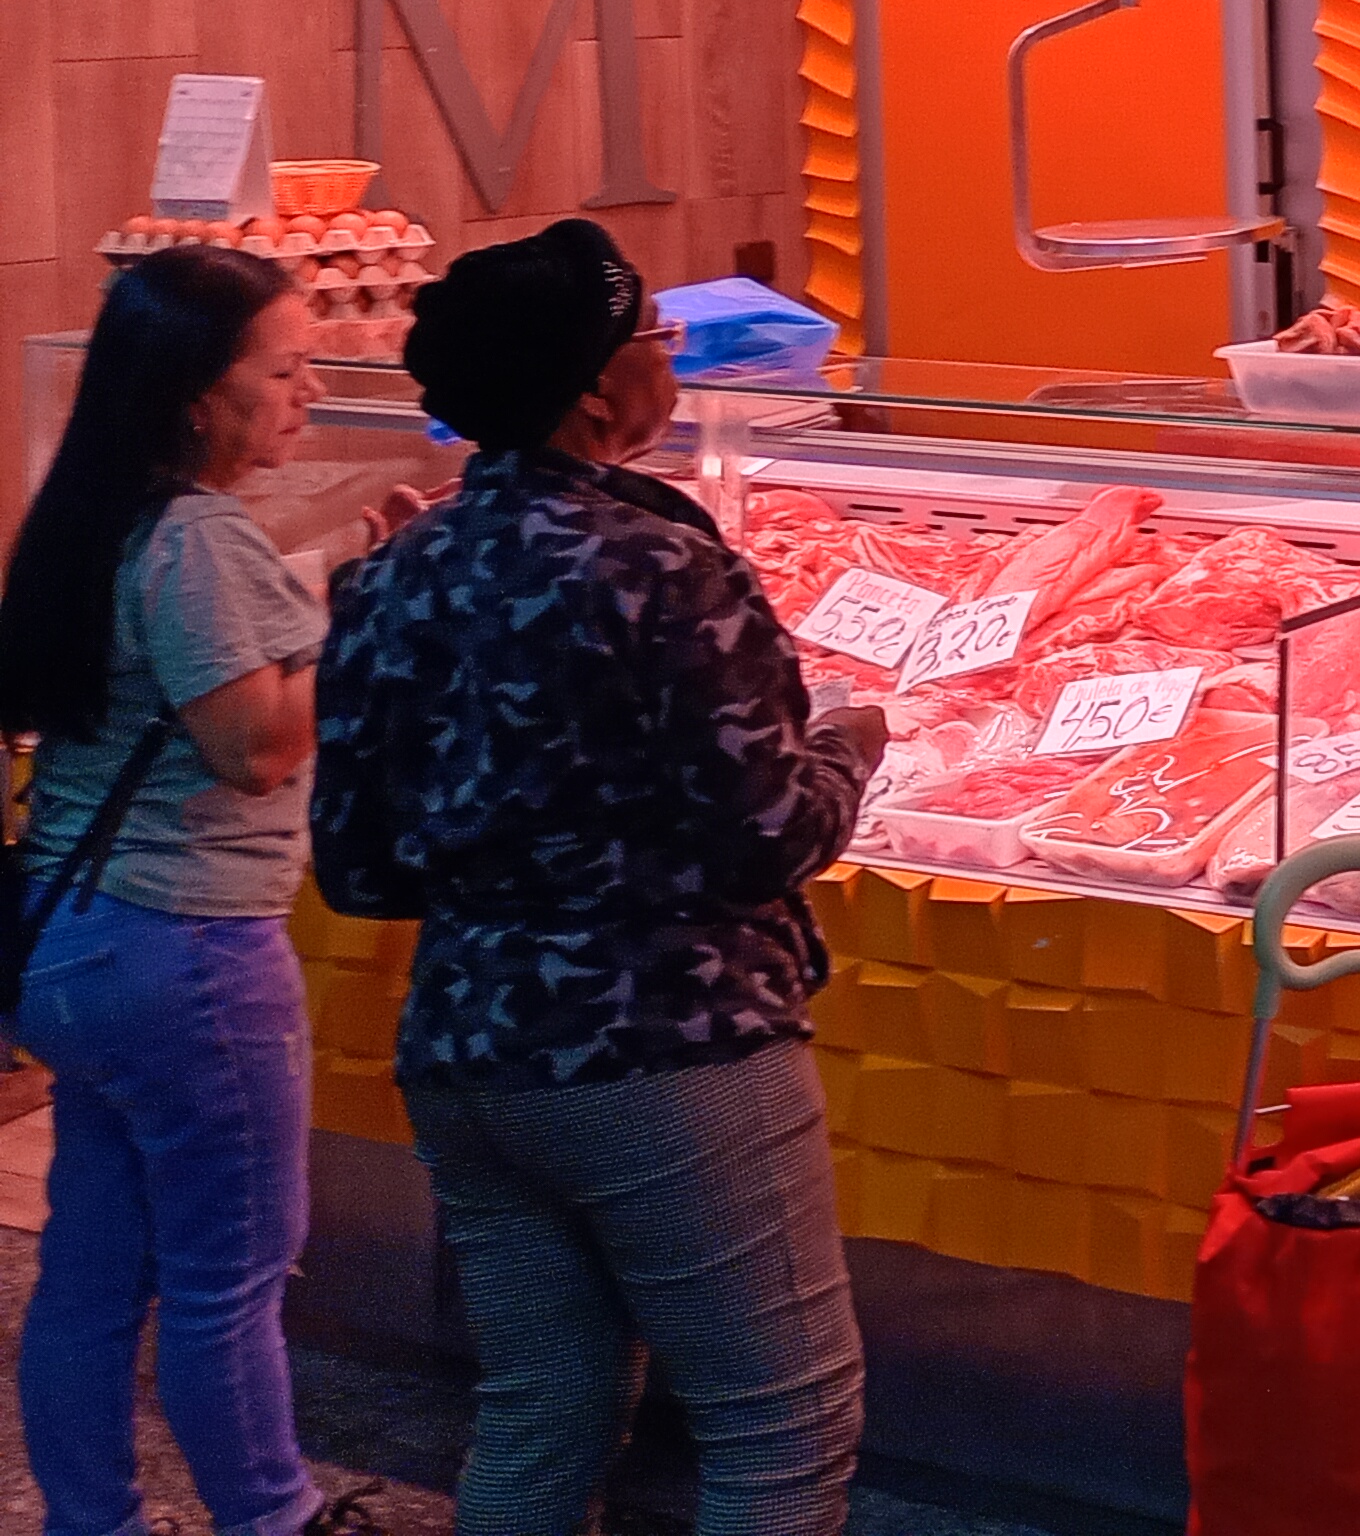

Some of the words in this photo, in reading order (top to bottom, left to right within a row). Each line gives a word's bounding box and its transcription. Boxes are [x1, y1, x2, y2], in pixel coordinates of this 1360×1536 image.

[847, 571, 922, 614] Panceta
[1064, 678, 1123, 703] Chuleta
[1129, 676, 1150, 694] de
